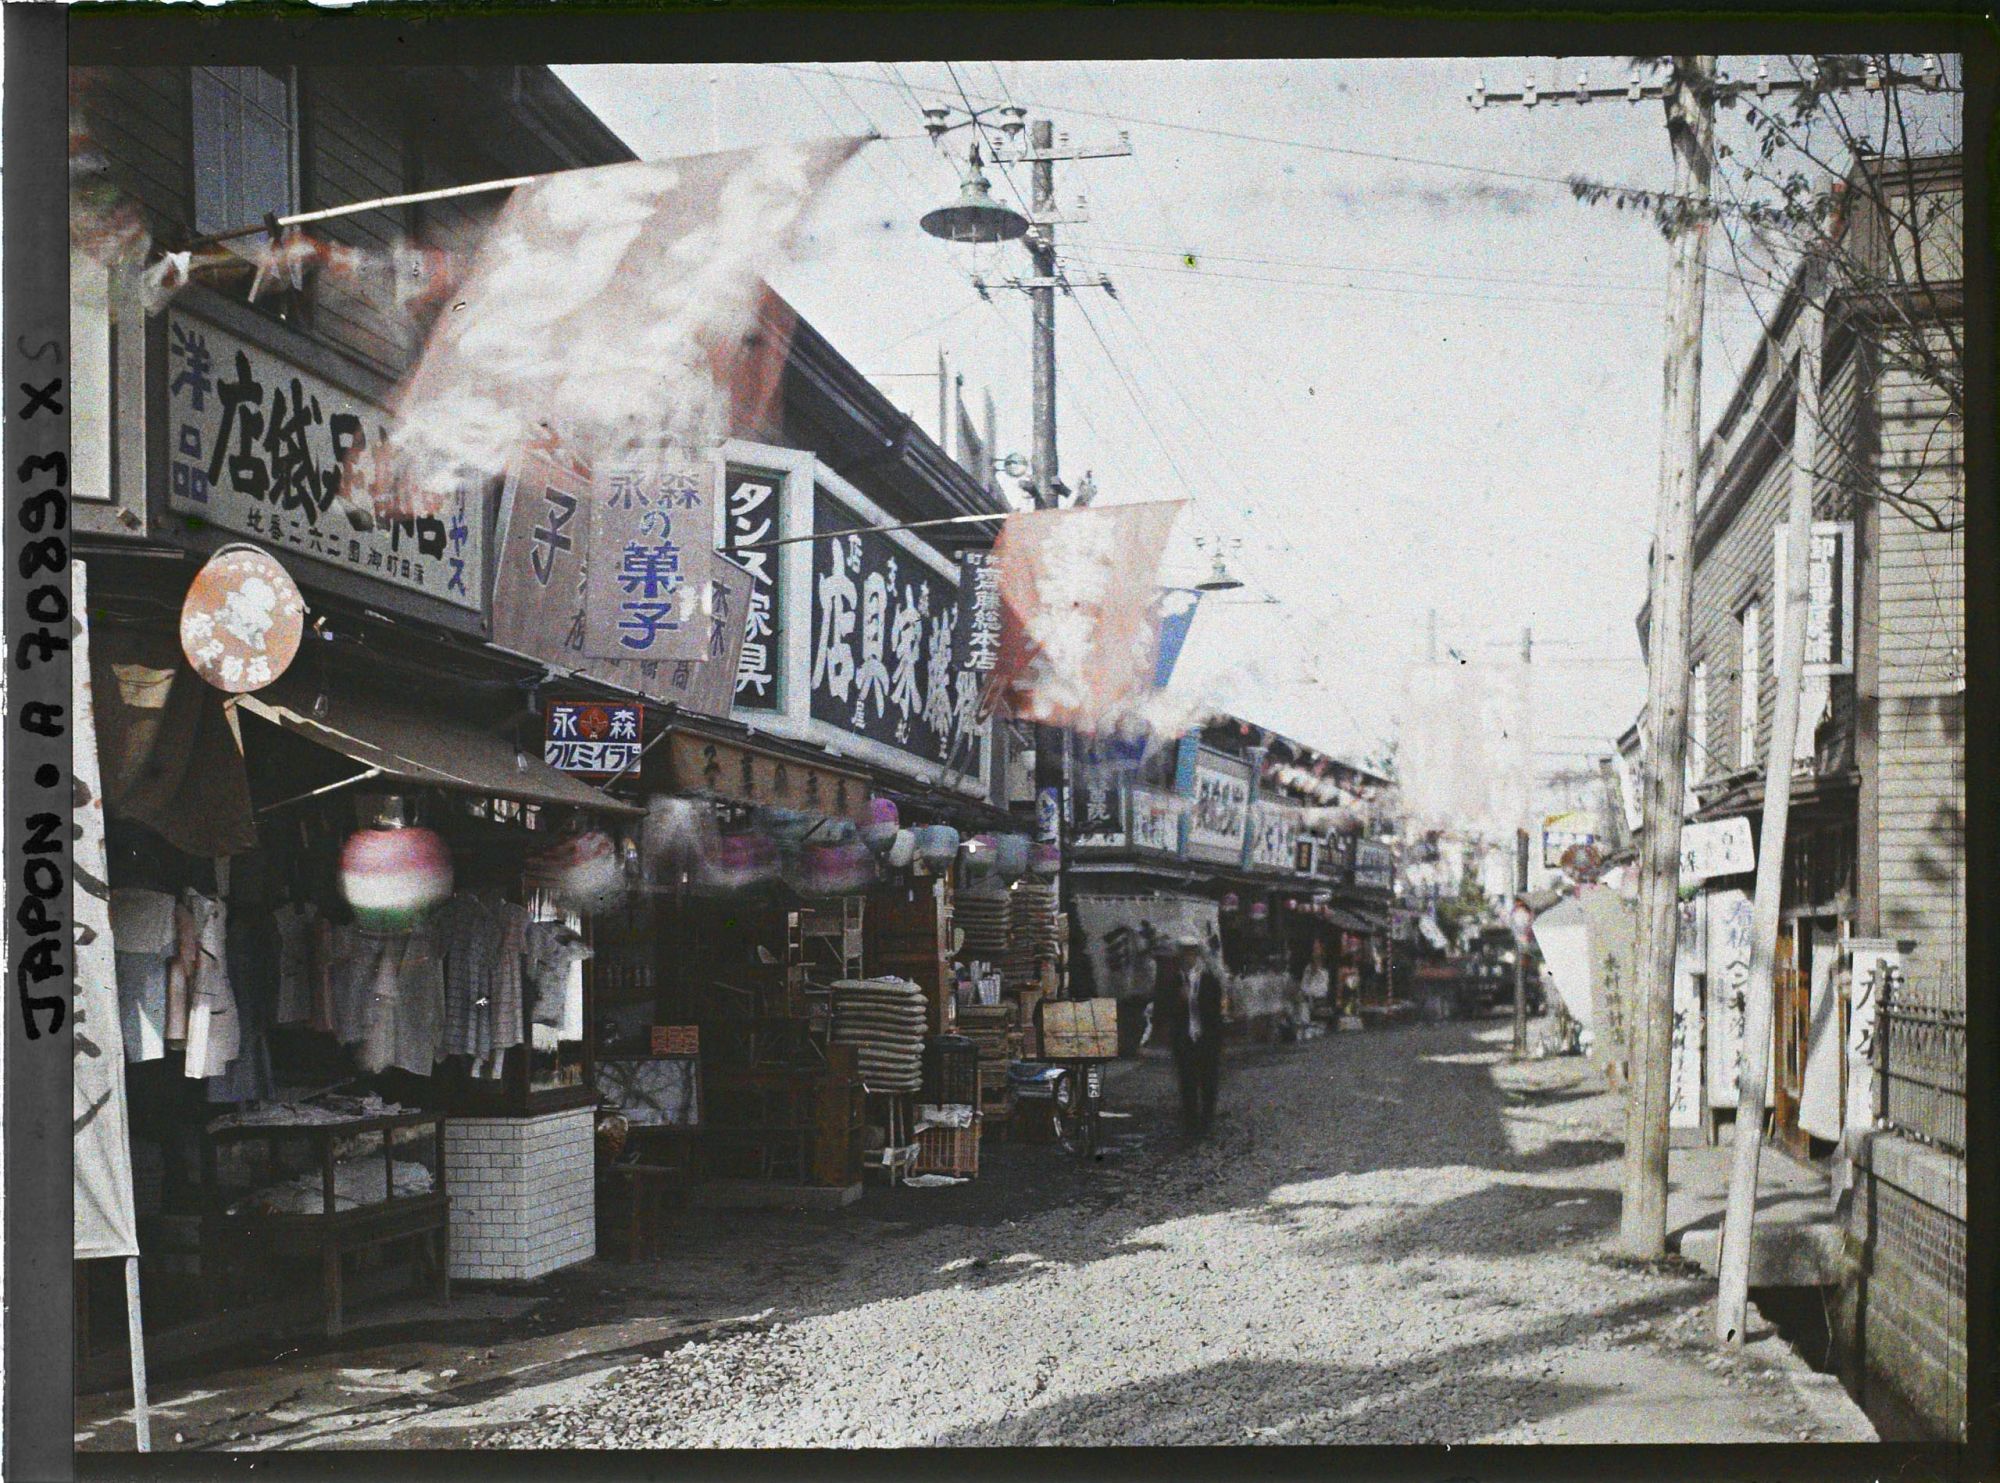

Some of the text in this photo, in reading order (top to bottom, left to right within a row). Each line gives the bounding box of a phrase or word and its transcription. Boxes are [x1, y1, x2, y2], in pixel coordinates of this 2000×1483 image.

[16, 450, 69, 670] 70893
[20, 702, 64, 737] A
[17, 811, 66, 1040] JAPON
